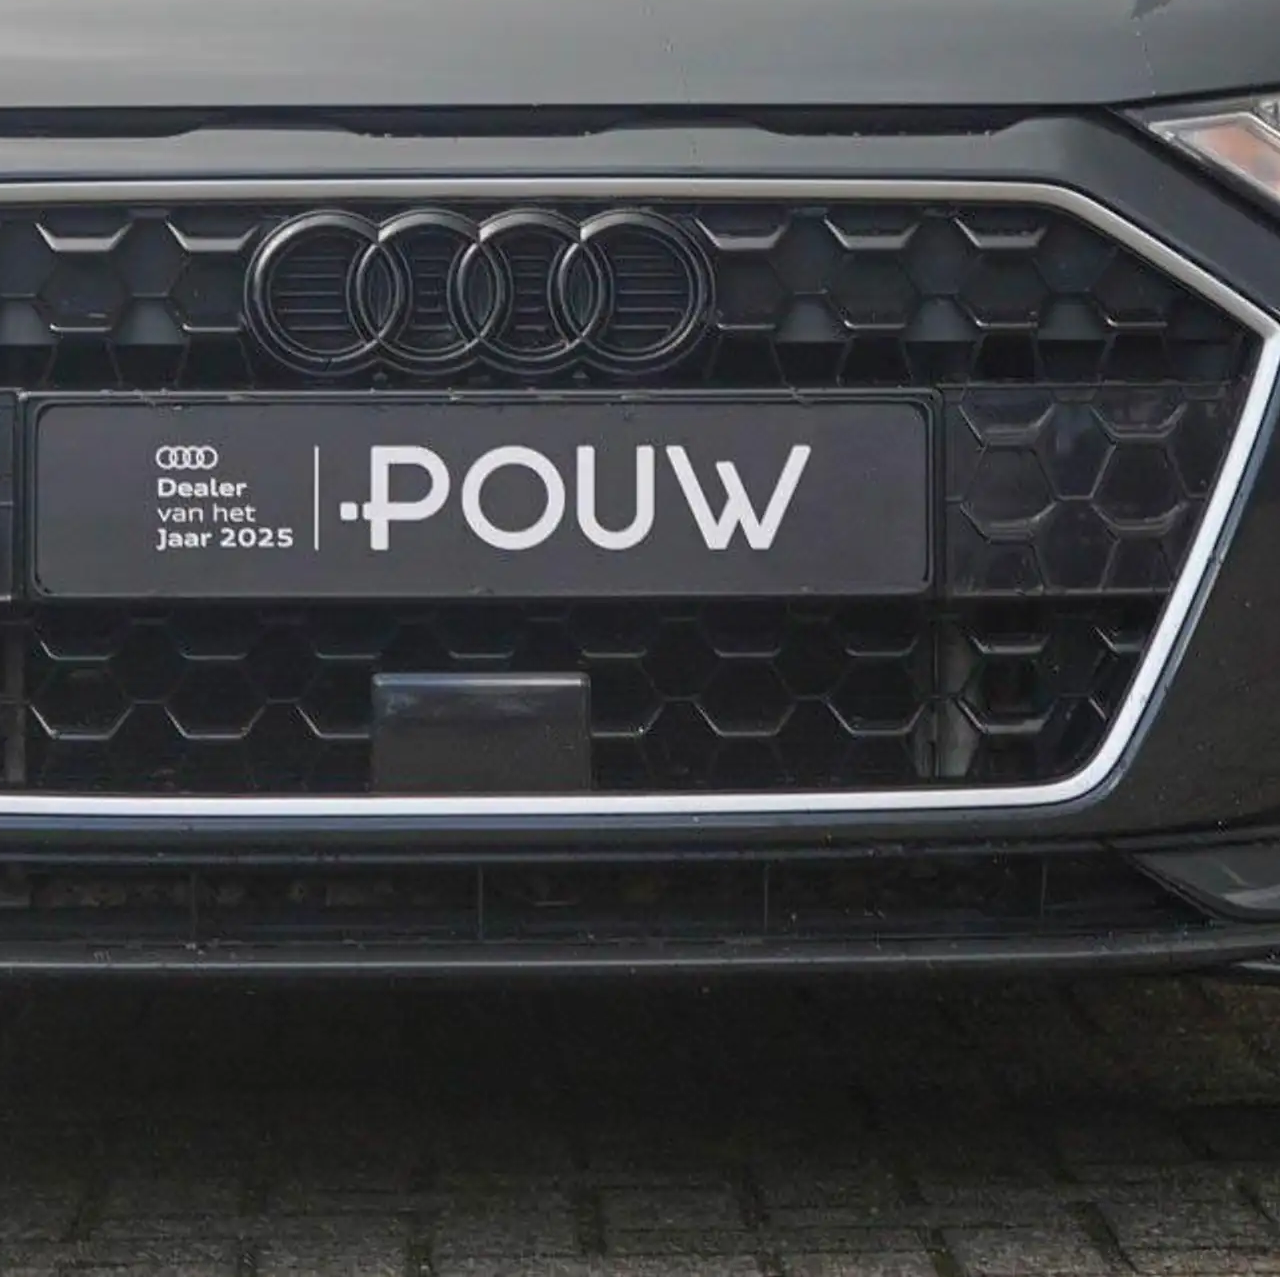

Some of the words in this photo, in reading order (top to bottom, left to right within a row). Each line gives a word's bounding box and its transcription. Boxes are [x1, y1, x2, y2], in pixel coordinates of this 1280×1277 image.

[157, 477, 249, 498] Dealer
[361, 444, 812, 551] POUW
[157, 506, 205, 523] van
[212, 503, 257, 523] het
[155, 527, 214, 551] Jaar
[219, 527, 295, 548] 2025
